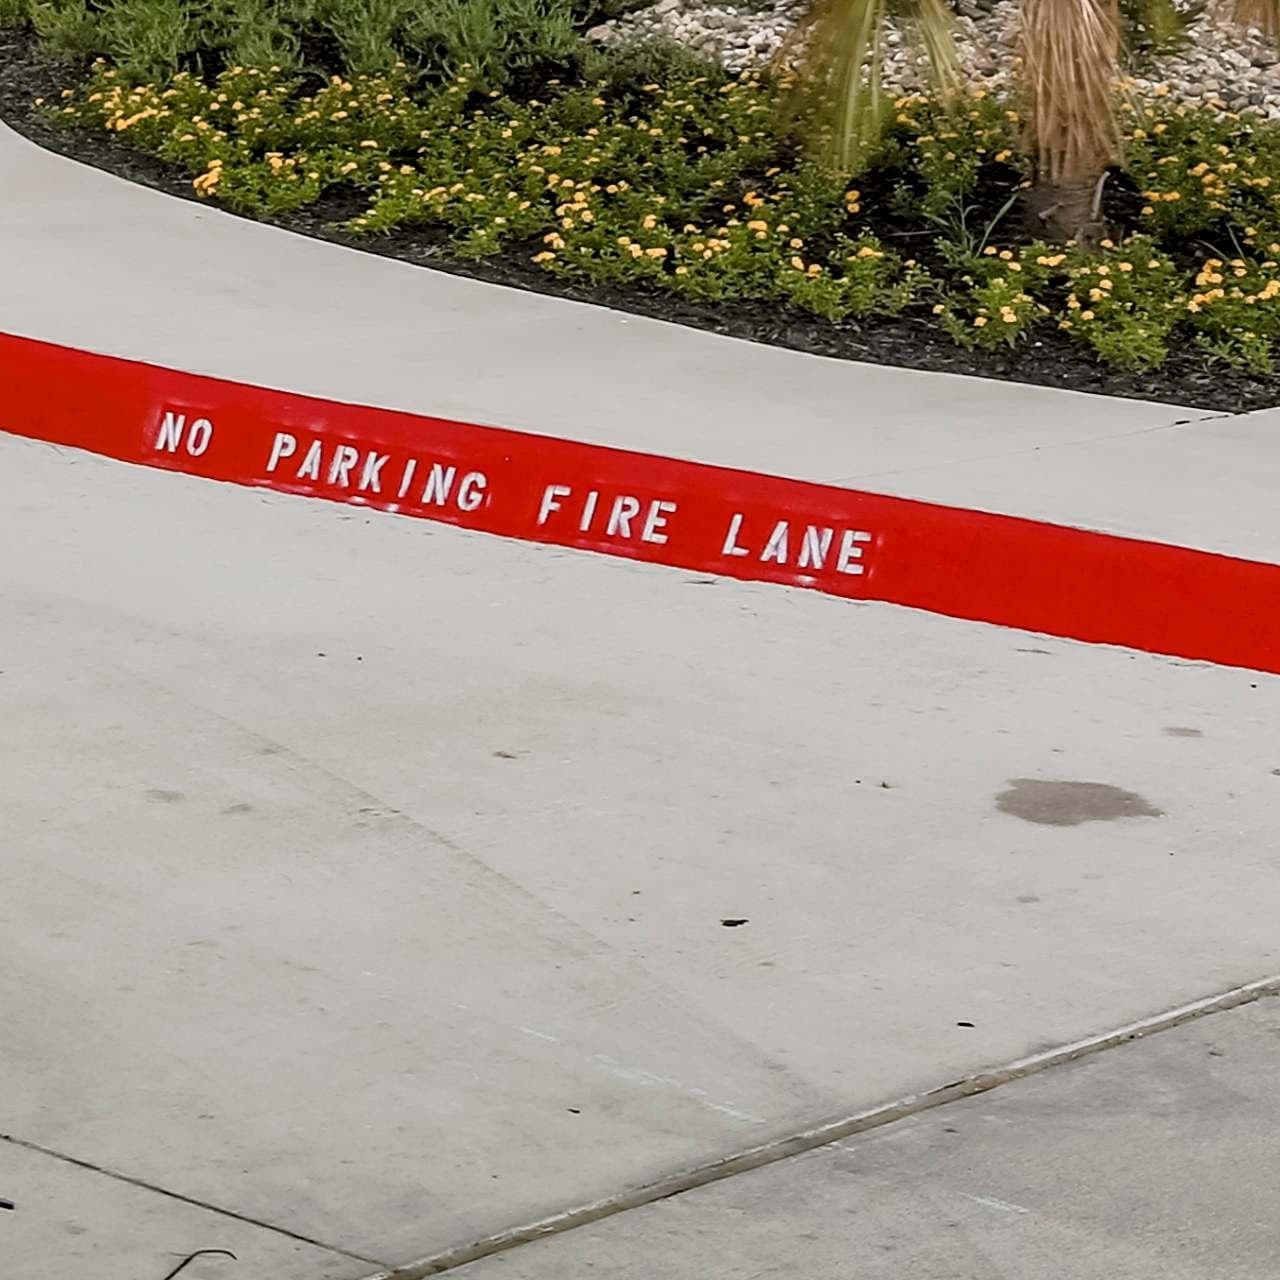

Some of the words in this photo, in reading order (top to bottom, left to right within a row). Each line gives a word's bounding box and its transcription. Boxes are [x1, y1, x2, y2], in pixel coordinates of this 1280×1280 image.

[154, 412, 213, 456] NO
[265, 432, 488, 512] PARKING
[537, 484, 678, 544] FIRE
[722, 513, 872, 575] LANE
